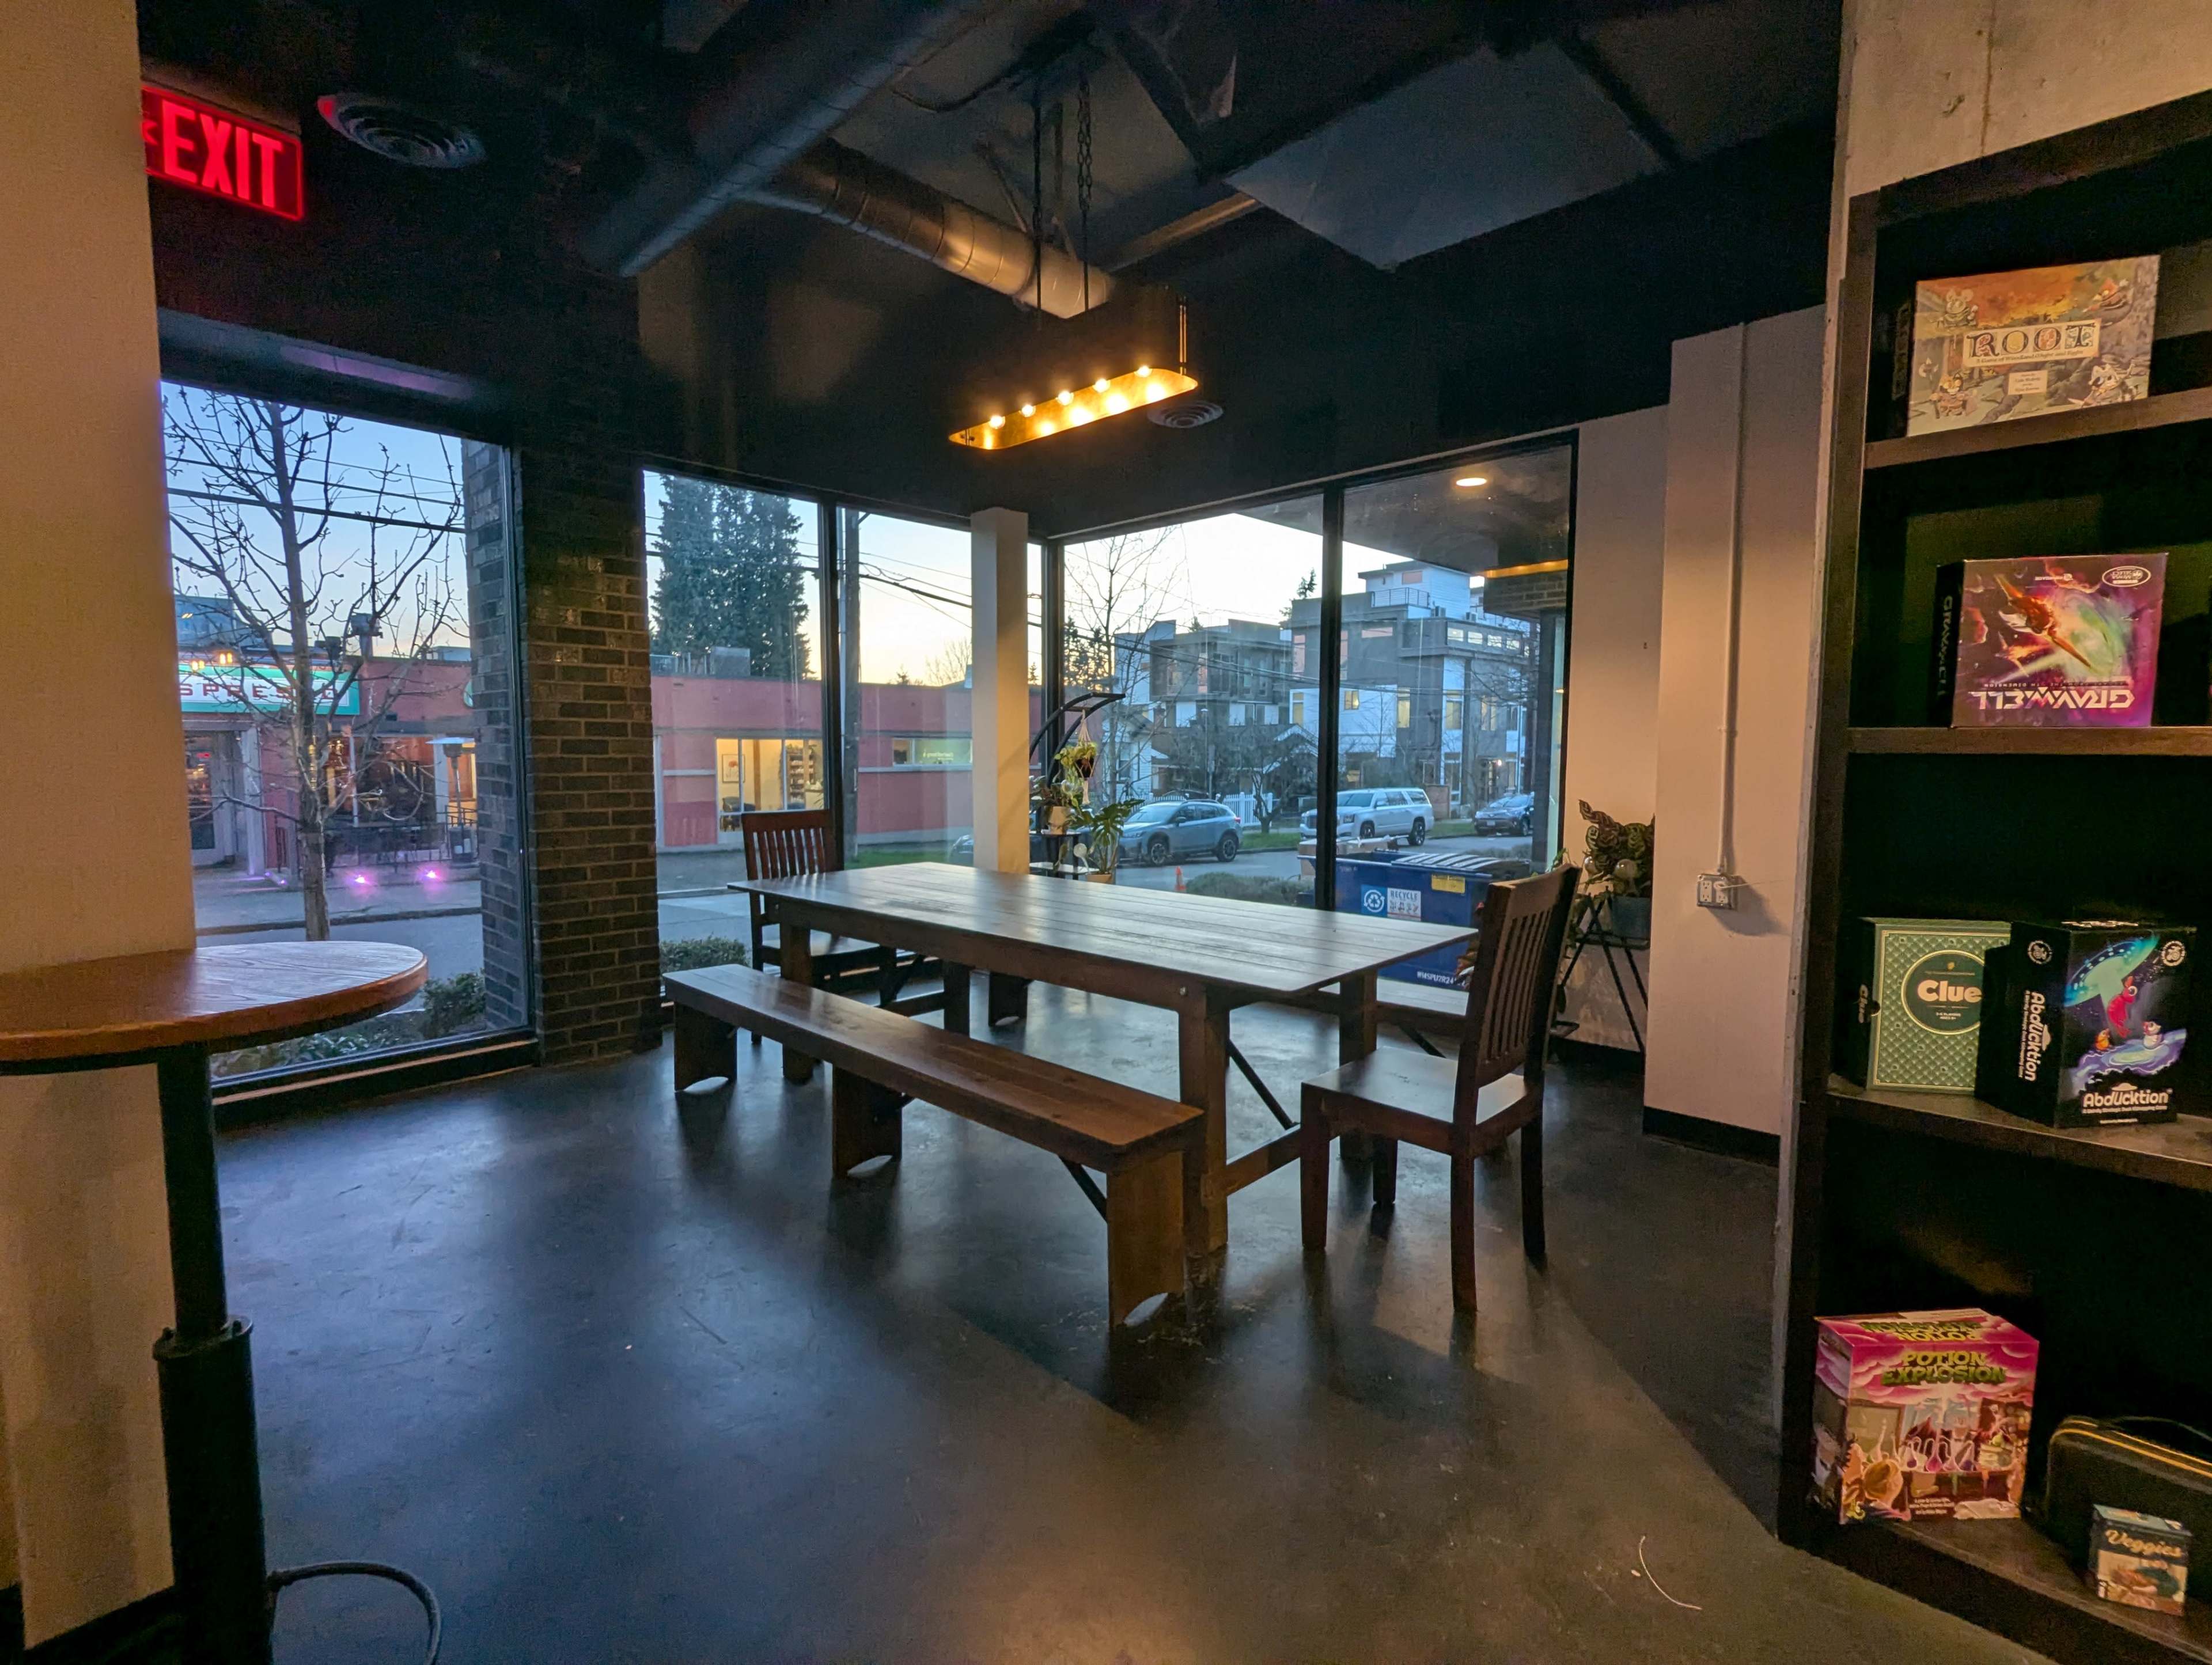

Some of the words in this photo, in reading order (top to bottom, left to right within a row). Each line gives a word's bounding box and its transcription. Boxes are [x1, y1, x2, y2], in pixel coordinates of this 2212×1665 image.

[162, 99, 283, 208] EXIT
[1966, 323, 2096, 357] ROOT
[1969, 687, 2135, 710] GRAVWELL
[1390, 890, 1418, 901] RECYCLE
[1917, 979, 1982, 1003] Clue
[1902, 1351, 1987, 1366] POTION
[1881, 1366, 2006, 1385] EXPLOSION
